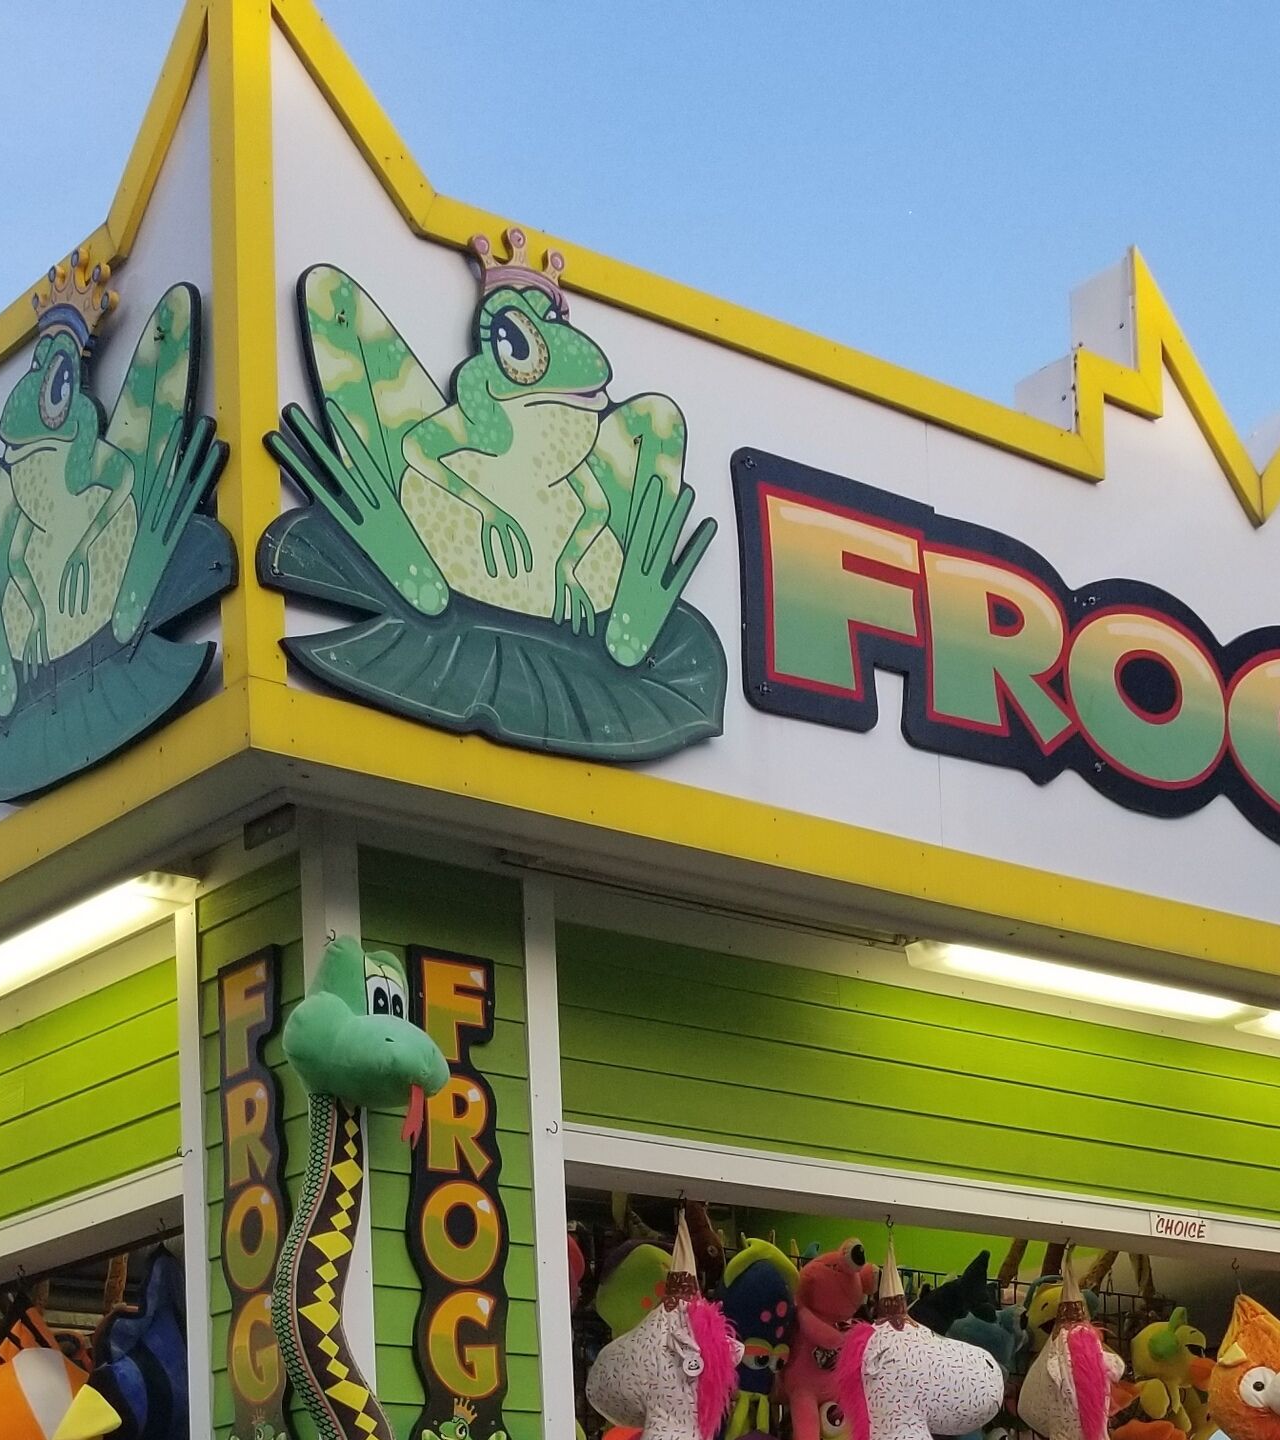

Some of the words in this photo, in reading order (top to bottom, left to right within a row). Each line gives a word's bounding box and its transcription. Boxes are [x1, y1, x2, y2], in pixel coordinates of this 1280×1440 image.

[222, 959, 282, 1402] FROG
[421, 957, 500, 1399] FROG
[1156, 1216, 1207, 1239] CHOICE
